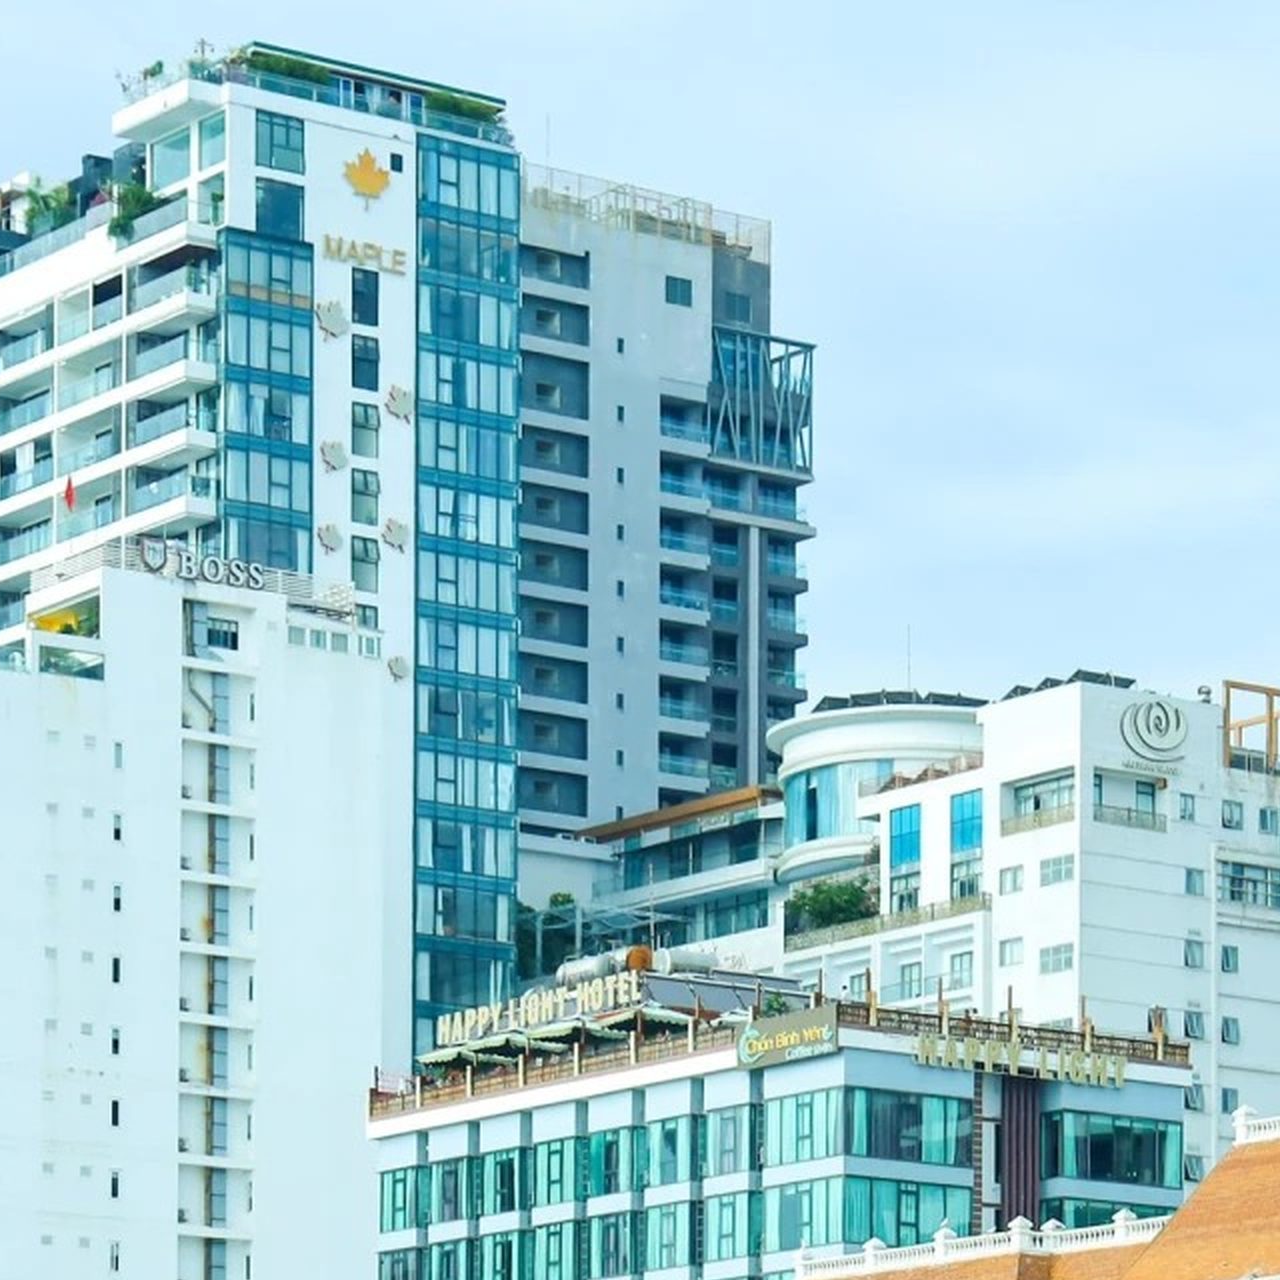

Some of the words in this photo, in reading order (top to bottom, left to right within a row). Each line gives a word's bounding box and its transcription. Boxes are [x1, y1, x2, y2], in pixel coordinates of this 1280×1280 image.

[323, 233, 407, 277] MAPLE
[177, 550, 265, 591] BOSS
[437, 1002, 503, 1045] HAPPY
[509, 984, 568, 1029] LIGHT
[576, 969, 643, 1014] HOTEL
[913, 1034, 1020, 1076] HAPPY
[1038, 1047, 1129, 1089] LIGHT
